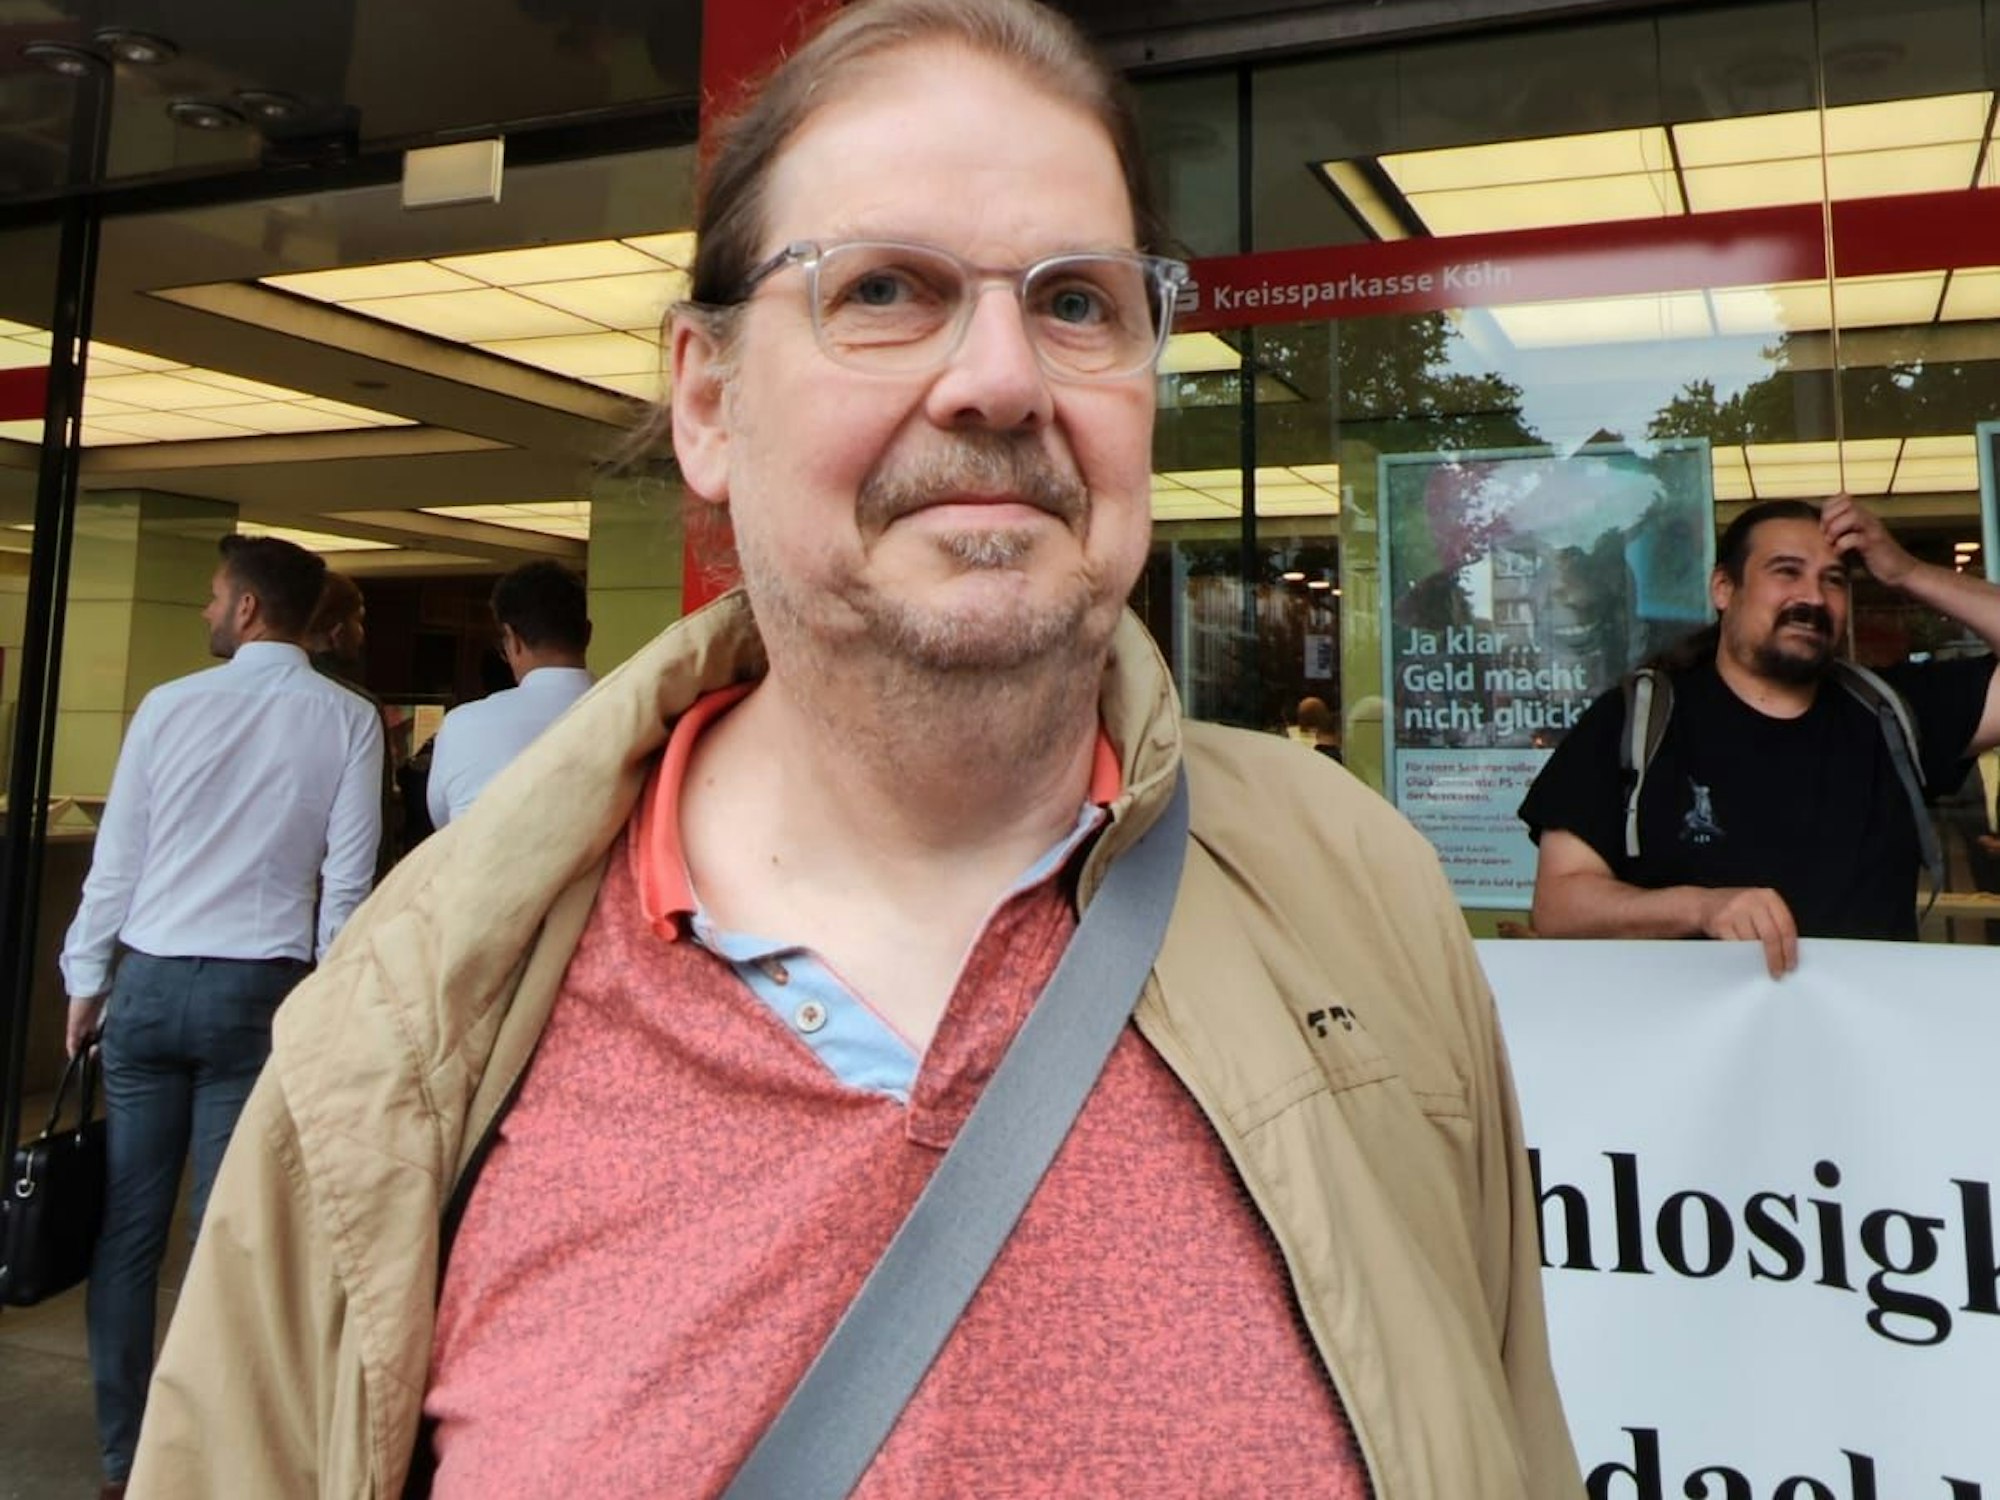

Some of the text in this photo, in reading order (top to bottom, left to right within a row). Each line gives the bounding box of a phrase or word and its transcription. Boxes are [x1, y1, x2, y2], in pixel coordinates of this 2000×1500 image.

[1214, 274, 1433, 309] Kreissparkasse
[1442, 261, 1513, 290] Köln
[1403, 628, 1437, 655] Ja
[1403, 663, 1588, 692] Geld macht
[1405, 700, 1485, 731] nicht
